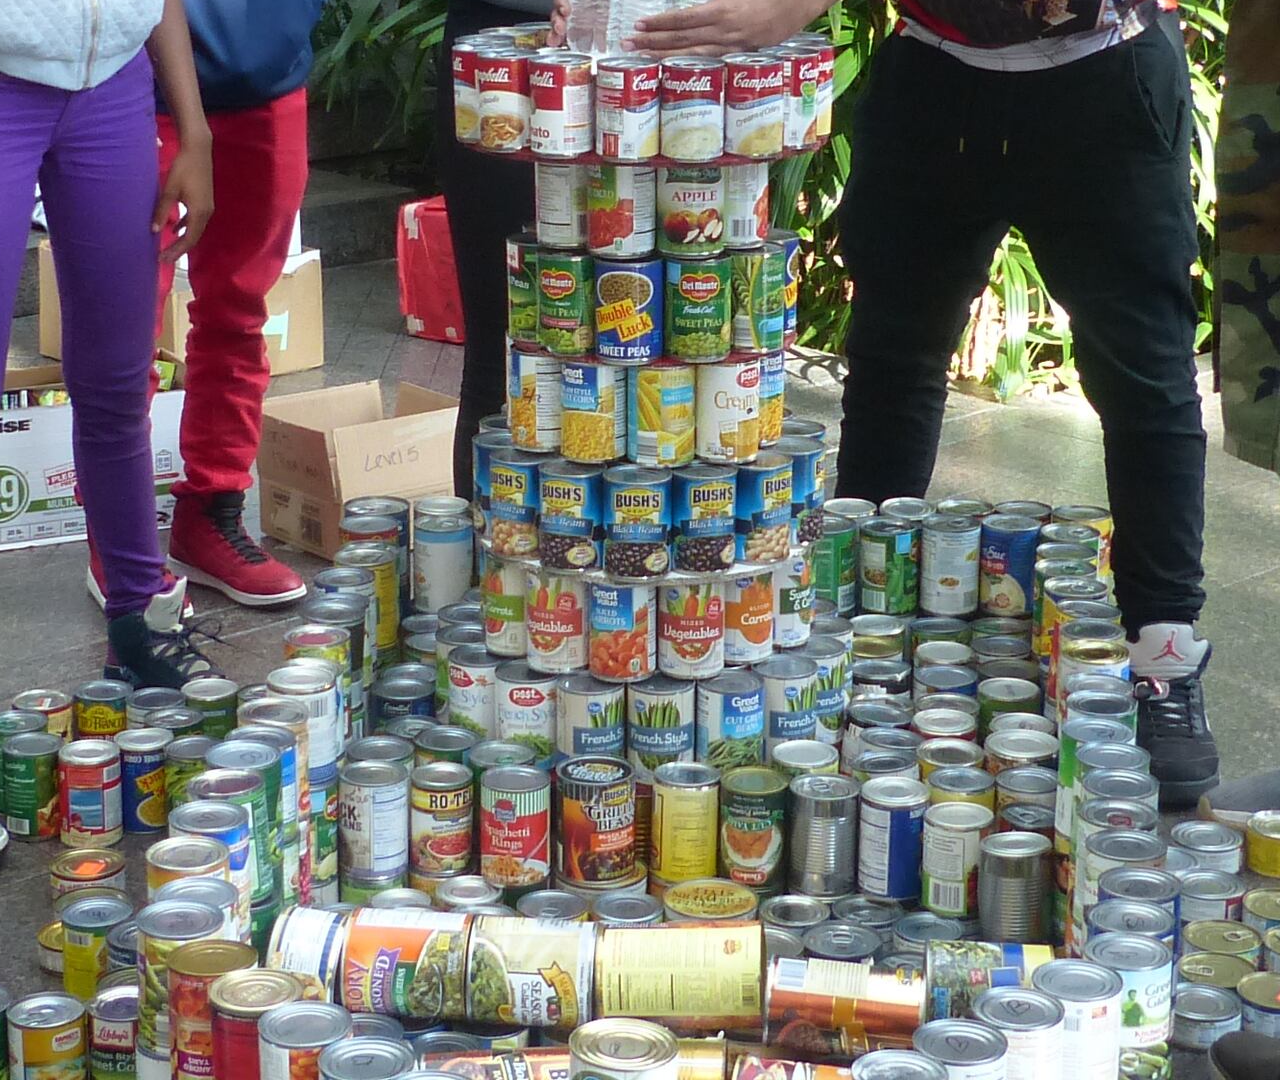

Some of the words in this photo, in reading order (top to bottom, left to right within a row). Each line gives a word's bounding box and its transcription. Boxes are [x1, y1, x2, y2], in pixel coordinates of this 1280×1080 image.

[672, 190, 717, 202] APPLE
[597, 306, 633, 325] Double
[618, 320, 651, 339] Luck
[599, 345, 624, 357] SWEET
[627, 345, 651, 357] PEAS
[365, 450, 402, 472] Level
[542, 484, 581, 502] BUSH'S
[615, 493, 660, 508] BUSH'S
[693, 486, 733, 504] BUSH'S
[664, 624, 720, 642] Vegetables
[732, 694, 759, 709] Great
[725, 716, 742, 724] CUT
[778, 716, 810, 729] French
[581, 732, 616, 746] French
[630, 731, 663, 745] French
[664, 731, 688, 746] Style
[485, 821, 530, 838] Spaghetti
[492, 834, 523, 852] Rings
[98, 1026, 130, 1042] Libby's
